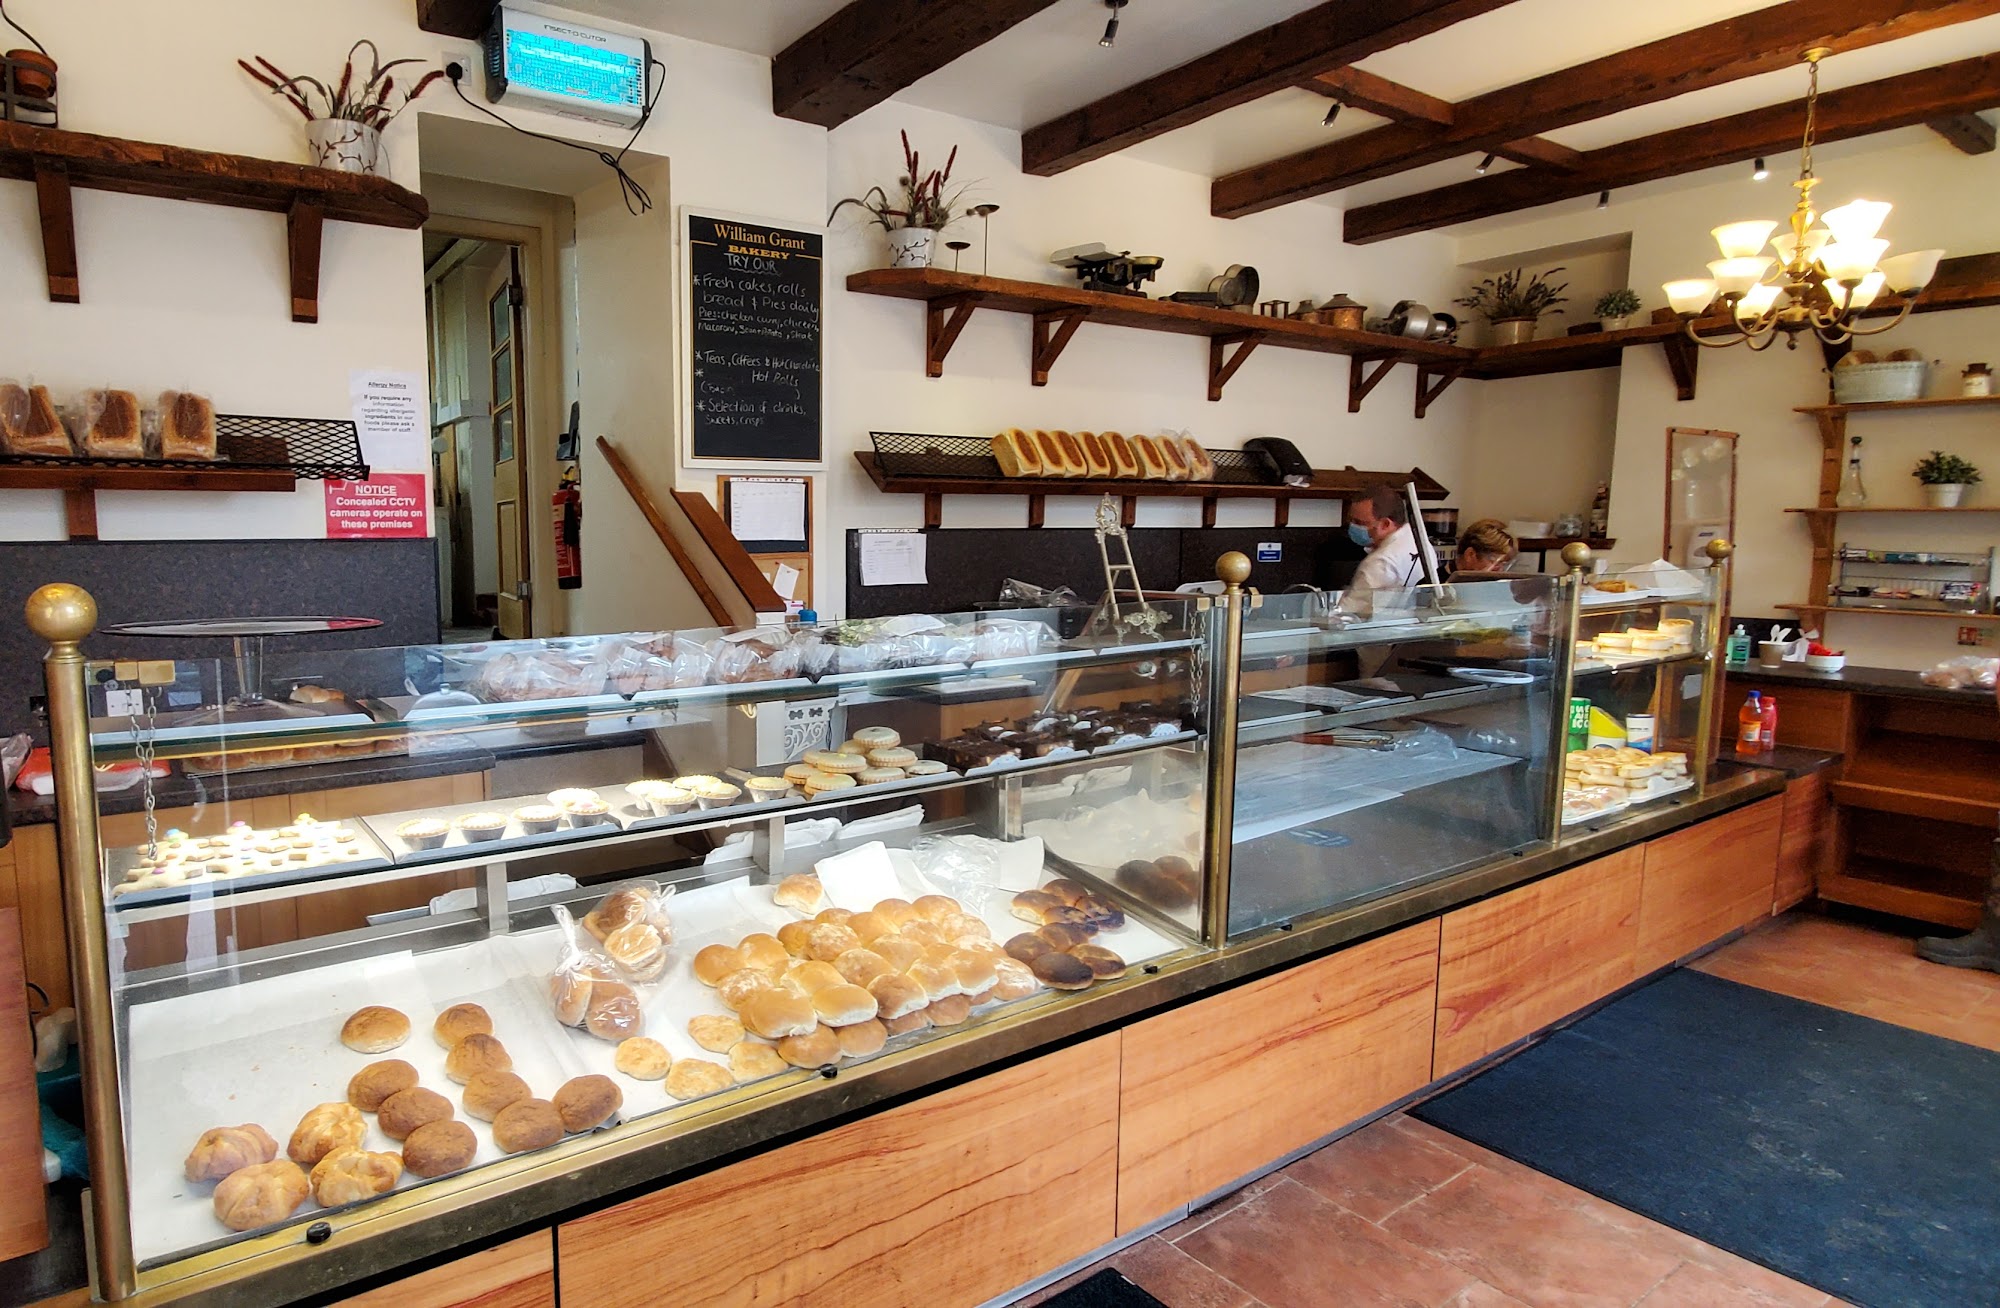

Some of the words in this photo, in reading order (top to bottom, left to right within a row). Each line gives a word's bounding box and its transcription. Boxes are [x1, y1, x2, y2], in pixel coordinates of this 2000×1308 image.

[714, 223, 766, 245] William
[769, 232, 806, 249] Grant
[728, 244, 790, 260] BAKERY
[724, 253, 749, 268] TRY
[753, 258, 777, 272] OUR
[703, 272, 735, 289] Fresh
[703, 290, 744, 307] bread
[762, 297, 786, 310] Pies
[789, 301, 819, 323] daily
[751, 370, 770, 384] Hot
[708, 398, 755, 414] Selection
[759, 400, 768, 414] of
[355, 484, 397, 495] NOTICE
[336, 496, 387, 507] Concealed
[389, 497, 416, 507] CCTV
[329, 508, 371, 518] cameras
[372, 508, 409, 519] operate
[410, 509, 423, 518] on
[341, 519, 369, 528] these
[370, 519, 413, 530] premises
